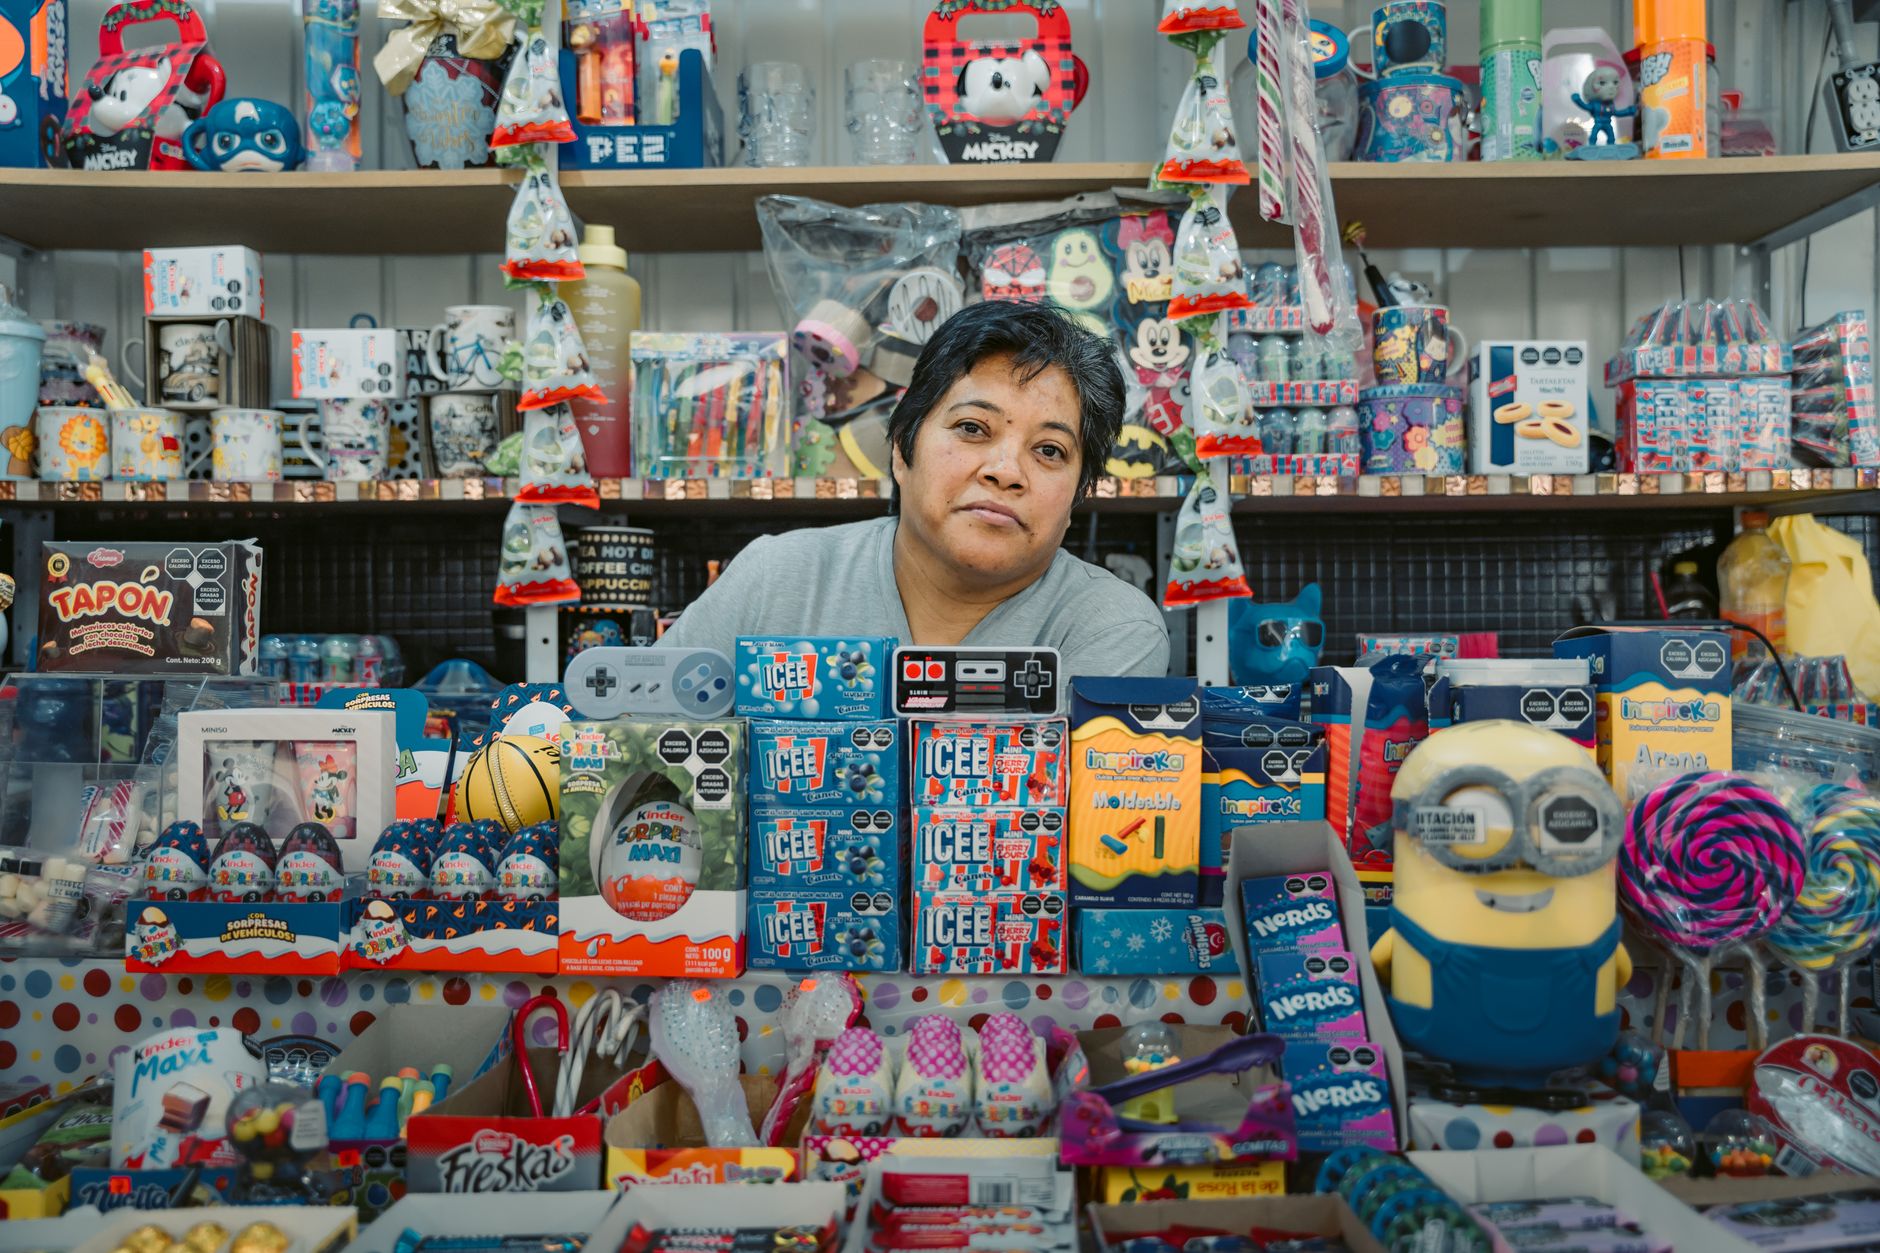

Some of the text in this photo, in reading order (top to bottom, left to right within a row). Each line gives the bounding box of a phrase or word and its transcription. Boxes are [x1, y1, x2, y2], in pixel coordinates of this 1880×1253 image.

[587, 135, 666, 163] PEZ
[962, 141, 1039, 161] MICKEY
[84, 150, 138, 171] MICKEY
[1639, 353, 1670, 370] ICEE
[1655, 386, 1677, 427] ICEE
[1706, 387, 1729, 426] ICEE
[1758, 386, 1780, 426] ICEE
[602, 547, 637, 558] HOT
[70, 622, 154, 640] Malvaviscos cubiertos
[84, 631, 138, 641] con chocolate
[70, 639, 155, 656] con leche descremada
[764, 662, 809, 691] ICEE
[345, 694, 390, 708] SORPRESAS
[575, 732, 605, 740] Kinder
[561, 741, 620, 757] SORPRESA
[1636, 744, 1708, 770] Arena
[571, 757, 605, 770] MAXI
[766, 747, 818, 781] ICEE
[923, 738, 989, 778] ICEE
[995, 759, 1028, 767] CHERRY
[1093, 792, 1181, 810] Moldeable
[637, 811, 686, 822] Kinder
[1549, 819, 1593, 827] AZÚCARES
[616, 821, 702, 850] SORPRESA
[921, 823, 989, 863] ICEE
[628, 843, 682, 863] MAXI
[765, 829, 818, 863] ICEE
[996, 844, 1029, 852] CHERRY
[150, 854, 180, 864] Kinder
[221, 858, 255, 869] Kinder
[284, 859, 316, 869] Kinder
[372, 857, 402, 869] Kinder
[439, 857, 470, 869] Kinder
[505, 858, 535, 870] Kinder
[174, 888, 180, 898] 3
[664, 884, 683, 892] CONT.
[227, 919, 288, 931] SORPRESAS
[765, 911, 817, 945] ICEE
[923, 906, 990, 947] ICEE
[1253, 903, 1332, 937] Nerds
[140, 930, 169, 943] Kinder
[221, 926, 296, 942] DE VEHÍCULOS!
[365, 925, 395, 939] Kinder
[997, 926, 1031, 934] CHERRY
[998, 934, 1029, 942] SOURS
[131, 933, 184, 961] SORPRESA
[355, 927, 413, 958] SORPRESA
[1188, 914, 1211, 969] AIRHEADS
[702, 948, 722, 960] 100
[723, 948, 731, 962] g
[1269, 986, 1355, 1020] Nerds
[135, 1034, 193, 1063] Kinder
[132, 1043, 213, 1098] Maxi
[1292, 1080, 1382, 1116] Nerds
[1233, 1139, 1288, 1153] GOMITAS
[440, 1137, 574, 1193] Freskas
[1196, 1180, 1279, 1195] de la Rosa
